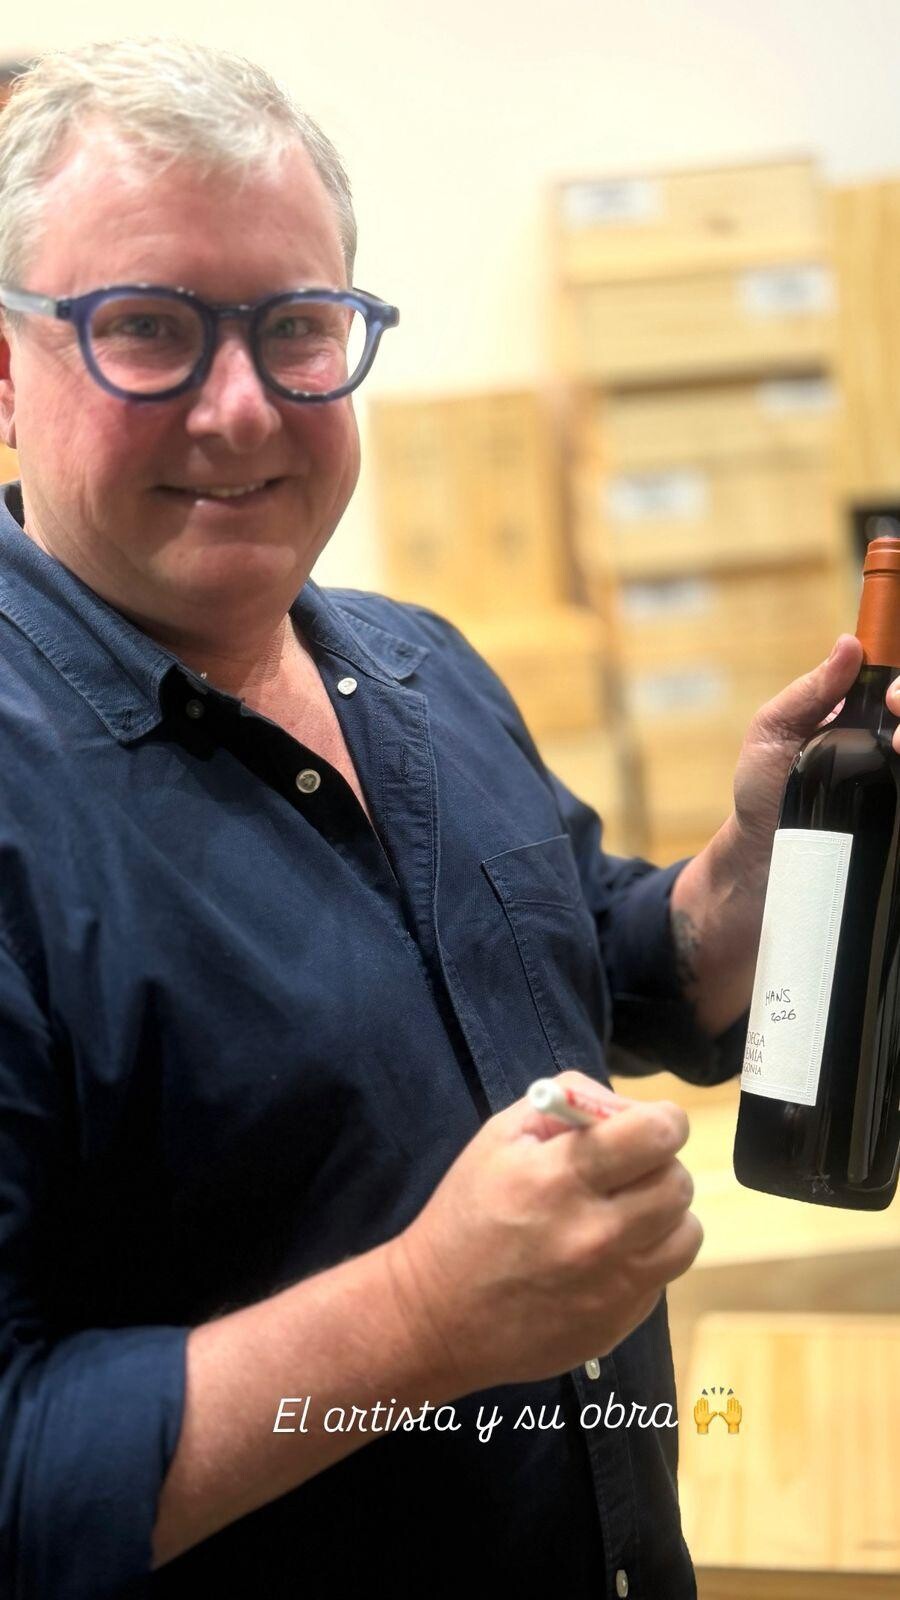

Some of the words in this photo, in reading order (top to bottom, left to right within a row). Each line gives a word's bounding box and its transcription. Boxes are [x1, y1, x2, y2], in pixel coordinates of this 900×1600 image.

[765, 988, 791, 1006] HANS
[770, 1008, 797, 1023] 2026
[747, 1031, 765, 1047] DEGA
[744, 1061, 761, 1076] GONIA
